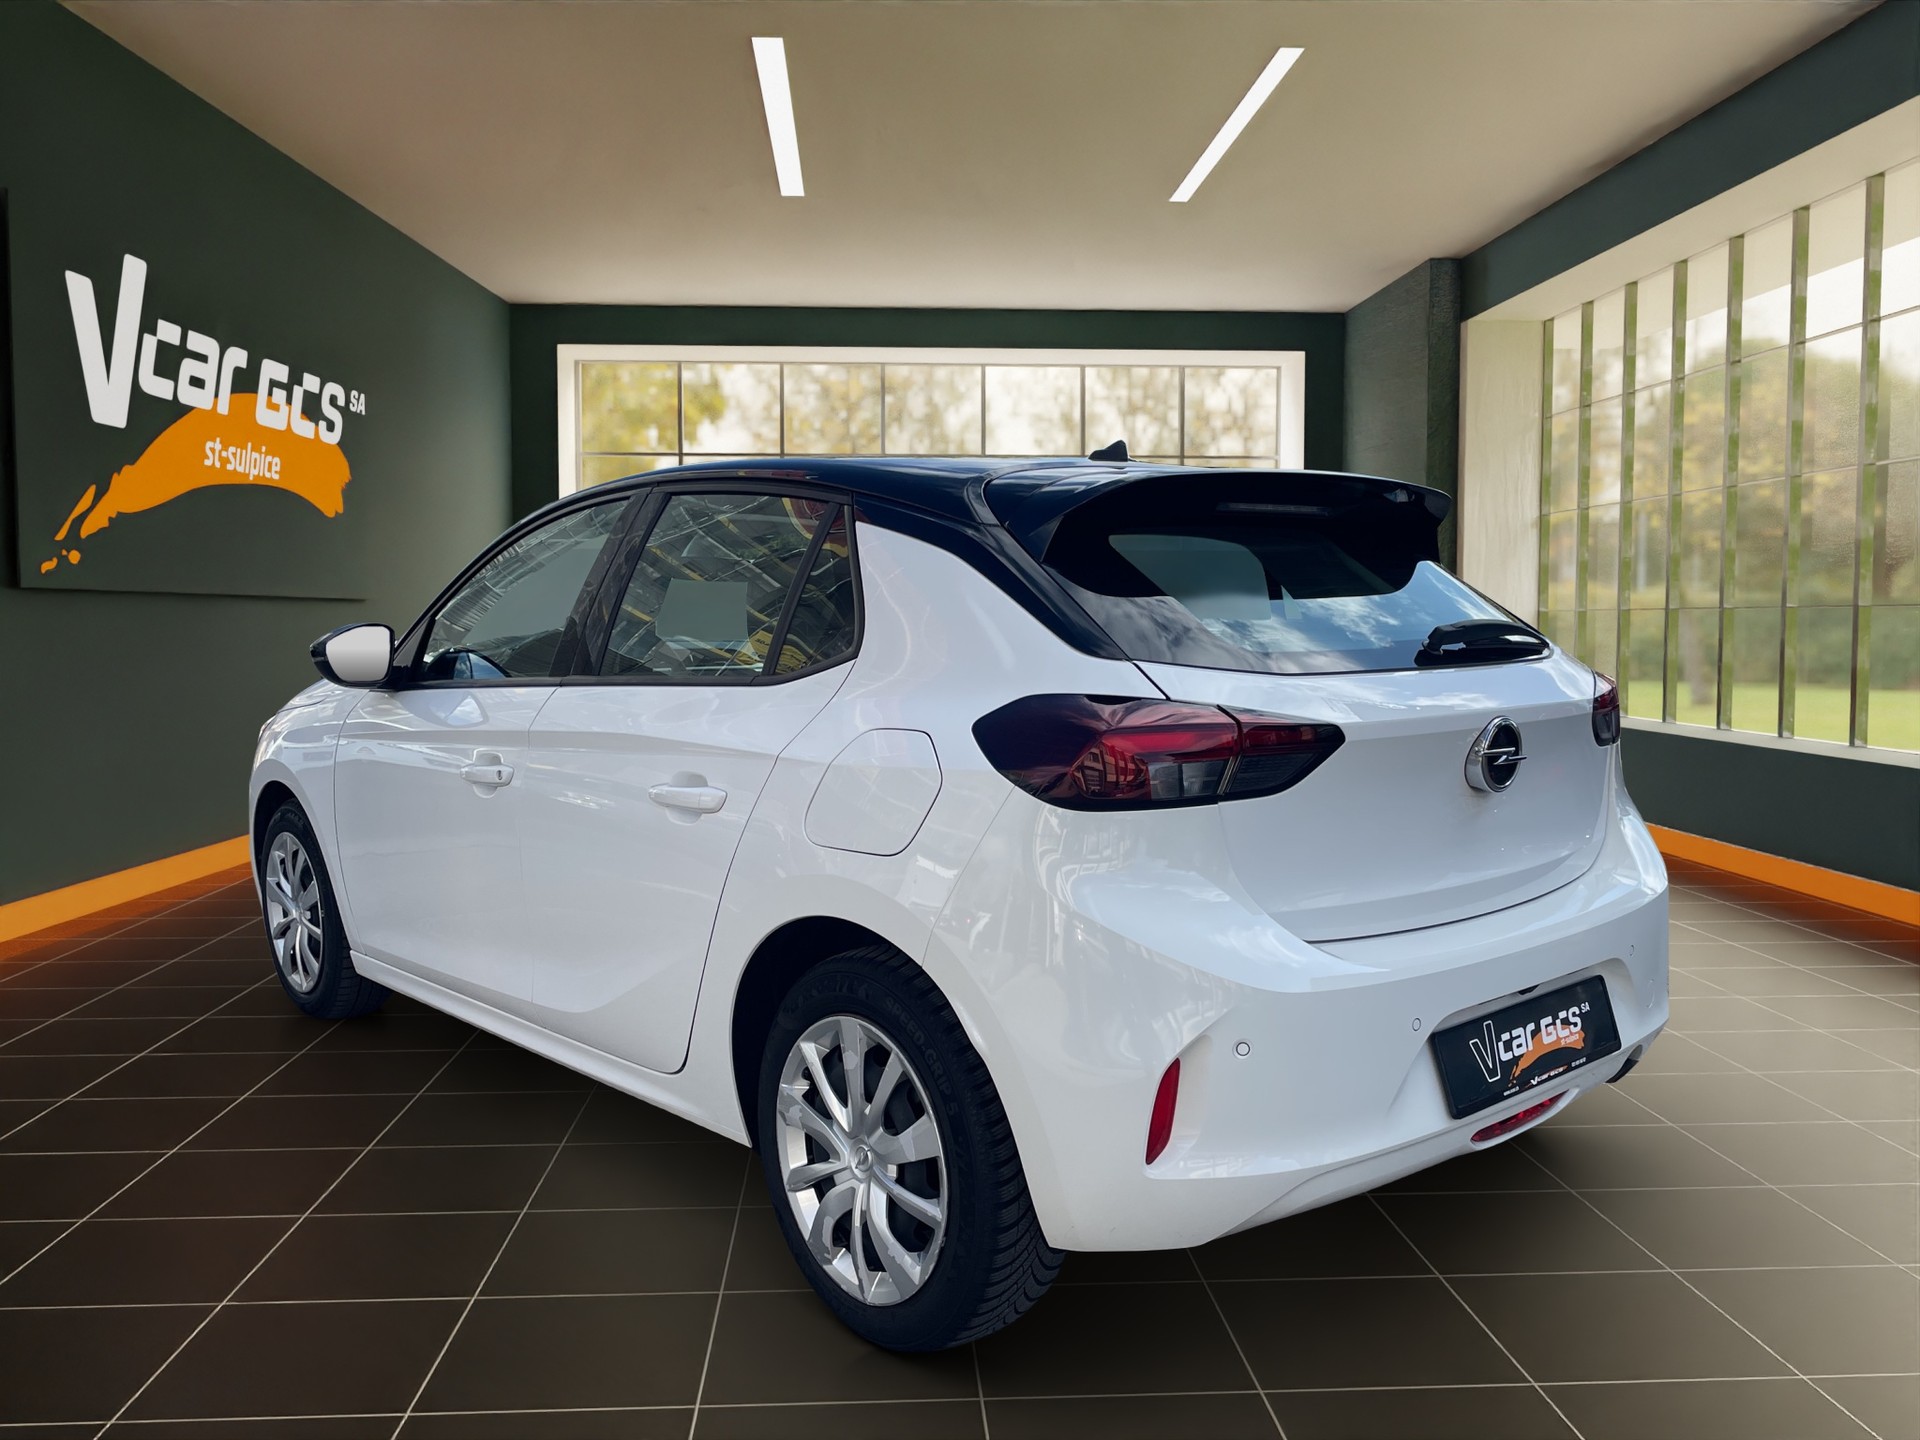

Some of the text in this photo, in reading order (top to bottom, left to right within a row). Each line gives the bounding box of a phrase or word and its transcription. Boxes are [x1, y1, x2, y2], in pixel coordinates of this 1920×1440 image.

[348, 389, 366, 416] SA
[203, 436, 282, 481] st-sulpice
[1580, 1001, 1591, 1014] SA
[946, 1102, 959, 1115] 5
